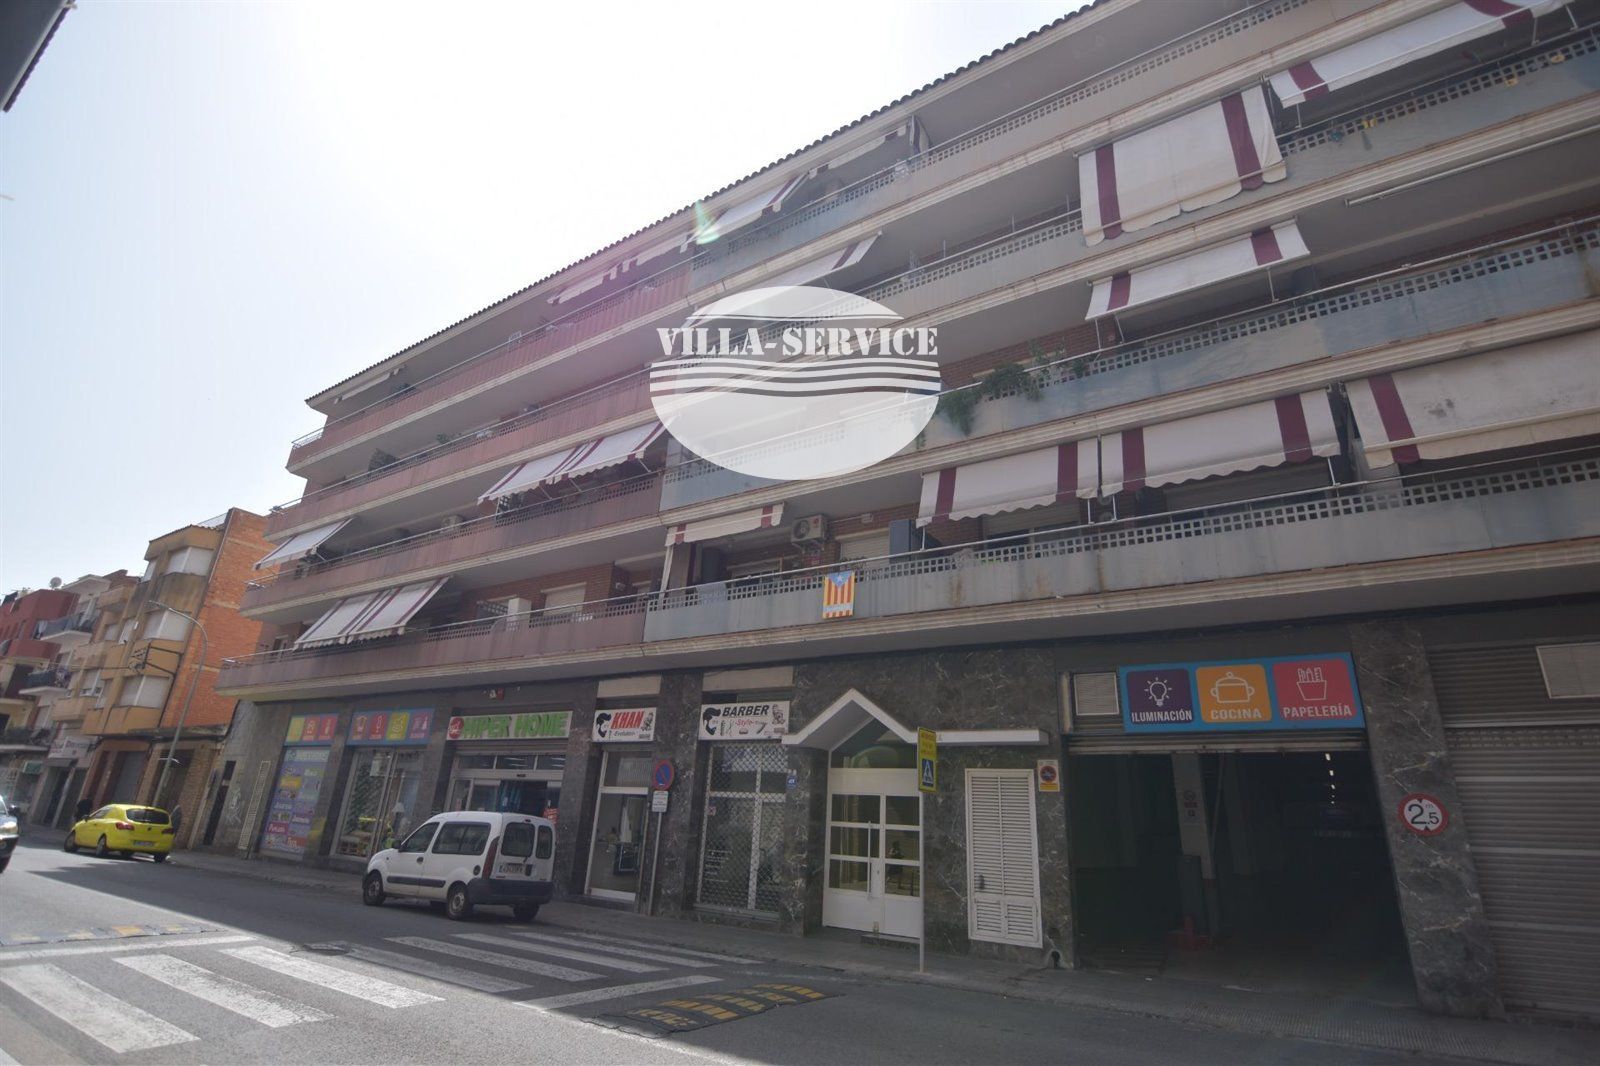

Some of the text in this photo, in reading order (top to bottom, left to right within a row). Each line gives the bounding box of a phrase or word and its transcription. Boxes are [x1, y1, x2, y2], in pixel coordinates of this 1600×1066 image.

[722, 705, 769, 717] BARBER
[1131, 708, 1193, 722] ILUMINACIÓN
[1211, 708, 1262, 720] COCINA
[1283, 704, 1352, 718] PAPELERÍA
[610, 711, 645, 729] KHAN
